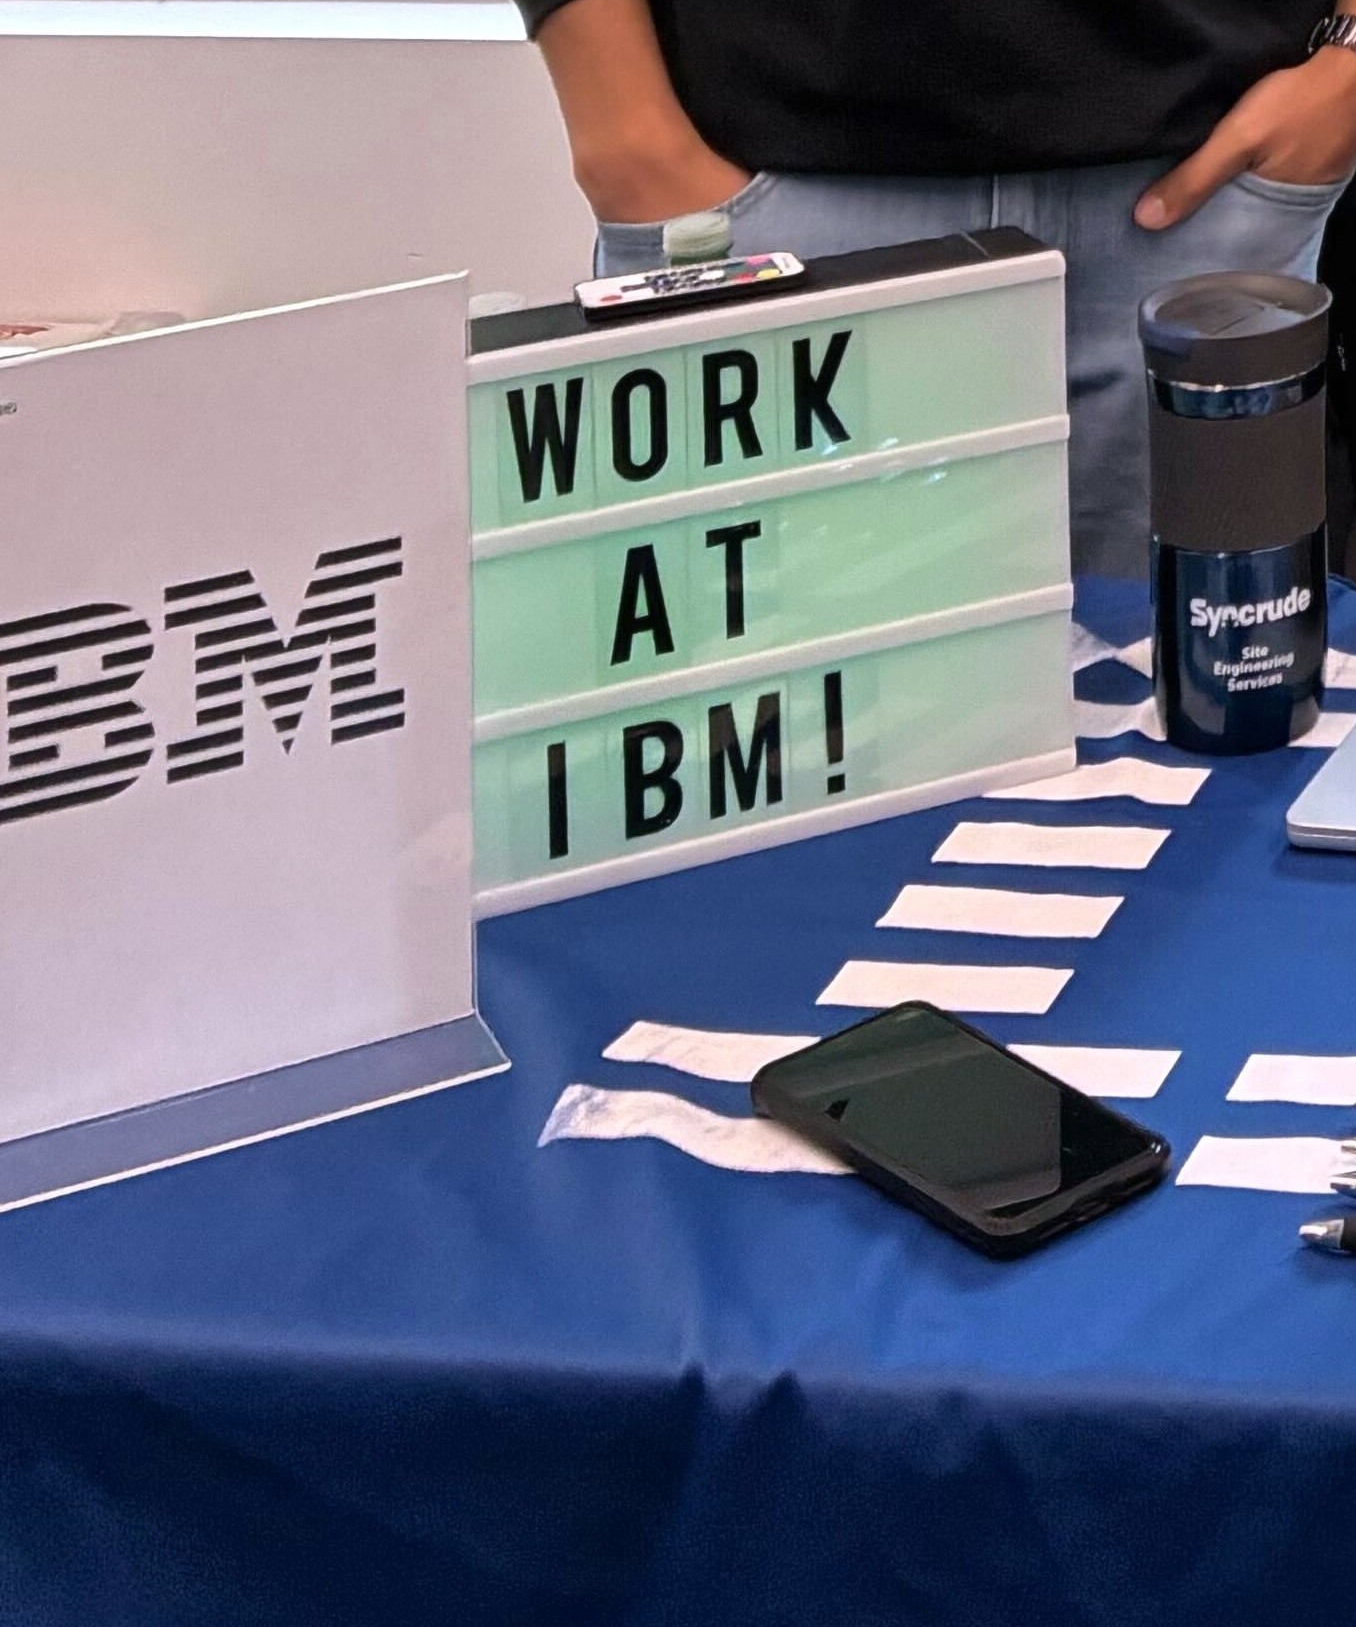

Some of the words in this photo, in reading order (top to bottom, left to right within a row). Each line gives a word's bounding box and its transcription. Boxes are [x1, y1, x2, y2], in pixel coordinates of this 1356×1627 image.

[506, 329, 853, 504] WORK
[608, 519, 762, 666] AT
[1189, 586, 1312, 638] Syncrude
[1213, 652, 1295, 677] Engineering
[1241, 644, 1269, 660] Site
[1227, 672, 1283, 692] Services
[546, 671, 848, 859] IBM!
